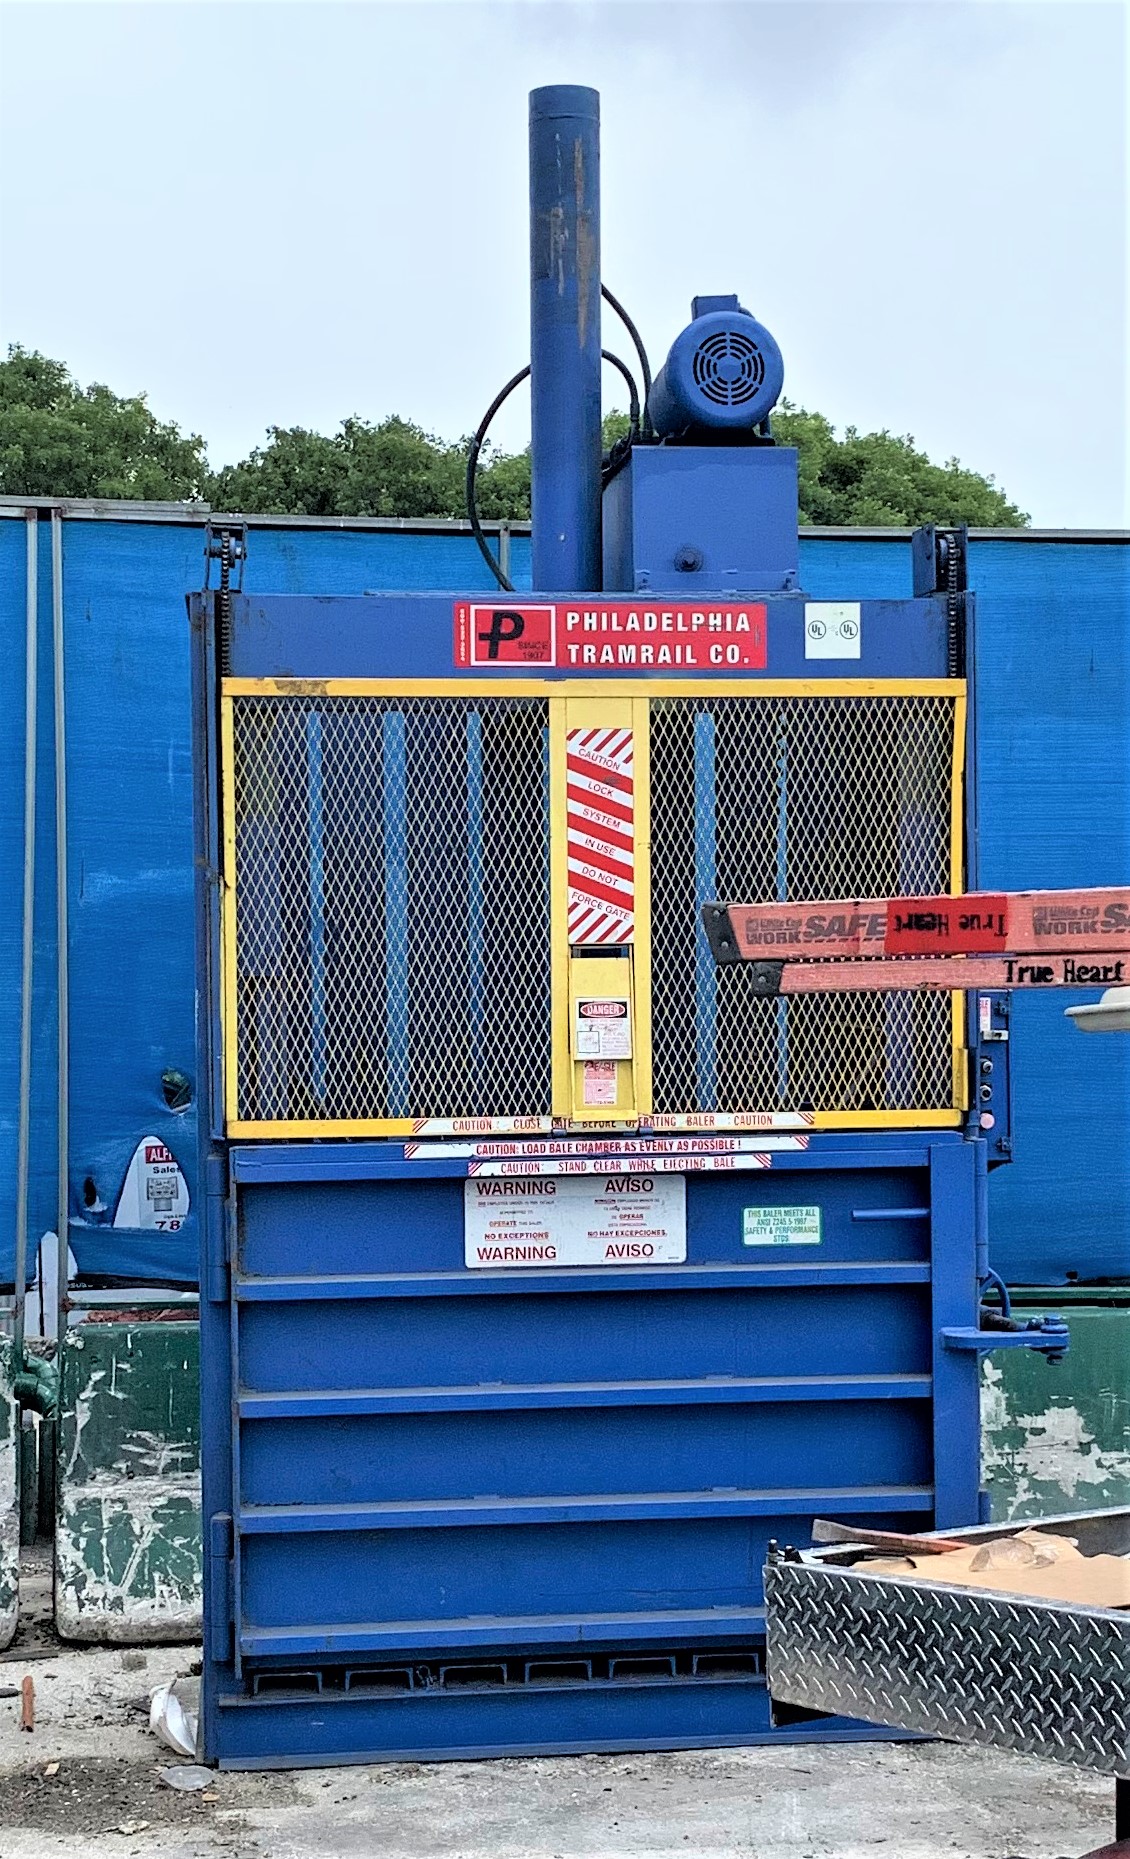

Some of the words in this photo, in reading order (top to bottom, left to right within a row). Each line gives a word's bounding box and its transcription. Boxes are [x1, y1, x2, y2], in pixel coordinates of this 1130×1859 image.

[566, 612, 750, 632] PHILADELPHIA
[567, 644, 697, 664] TRAMRAIL
[709, 644, 749, 664] CO.
[578, 748, 620, 771] CAUTION
[587, 781, 615, 798] LOCK
[582, 808, 621, 829] SYSTEM
[585, 838, 596, 849] IN
[597, 842, 616, 857] USE
[581, 866, 597, 878] DO
[597, 872, 618, 886] NOT
[571, 891, 603, 910] FORCE
[605, 904, 631, 921] GATE
[747, 932, 801, 945] WORK
[803, 914, 888, 938] SAFE
[894, 912, 949, 937] Heart
[959, 914, 1008, 937] True
[1033, 921, 1098, 935] WORK
[1003, 960, 1054, 983] True
[1063, 959, 1126, 983] Heart
[587, 1004, 620, 1015] DANGER
[452, 1119, 492, 1131] CAUTION
[513, 1117, 542, 1130] CLOSE
[582, 1120, 616, 1128] BEFORE
[625, 1116, 677, 1128] OPERATING
[686, 1115, 715, 1126] BALER
[734, 1114, 773, 1126] CAUTION
[476, 1144, 519, 1155] CAUTION:
[522, 1143, 546, 1154] LOAD
[549, 1142, 573, 1153] BALE
[575, 1141, 621, 1153] CHAMBER
[625, 1141, 637, 1152] AS
[640, 1140, 674, 1151] EVENLY
[677, 1140, 689, 1151] AS
[691, 1139, 735, 1150] POSSIBLE
[501, 1162, 544, 1173] CAUTION:
[558, 1161, 587, 1172] STAND
[593, 1160, 621, 1171] CLEAR
[663, 1158, 706, 1169] EJECTING
[714, 1157, 735, 1167] BALE
[476, 1181, 556, 1195] WARNING
[605, 1178, 654, 1193] AVISO
[748, 1210, 761, 1218] THIS
[763, 1209, 782, 1217] BALER
[784, 1208, 804, 1217] MEETS
[805, 1208, 816, 1217] ALL
[498, 1231, 549, 1239] EXCEPTIONS
[745, 1227, 767, 1235] SAFETY
[769, 1226, 773, 1234] &
[775, 1225, 818, 1234] PERFORMANCE
[477, 1246, 556, 1260] WARNING
[605, 1243, 654, 1258] AVISO
